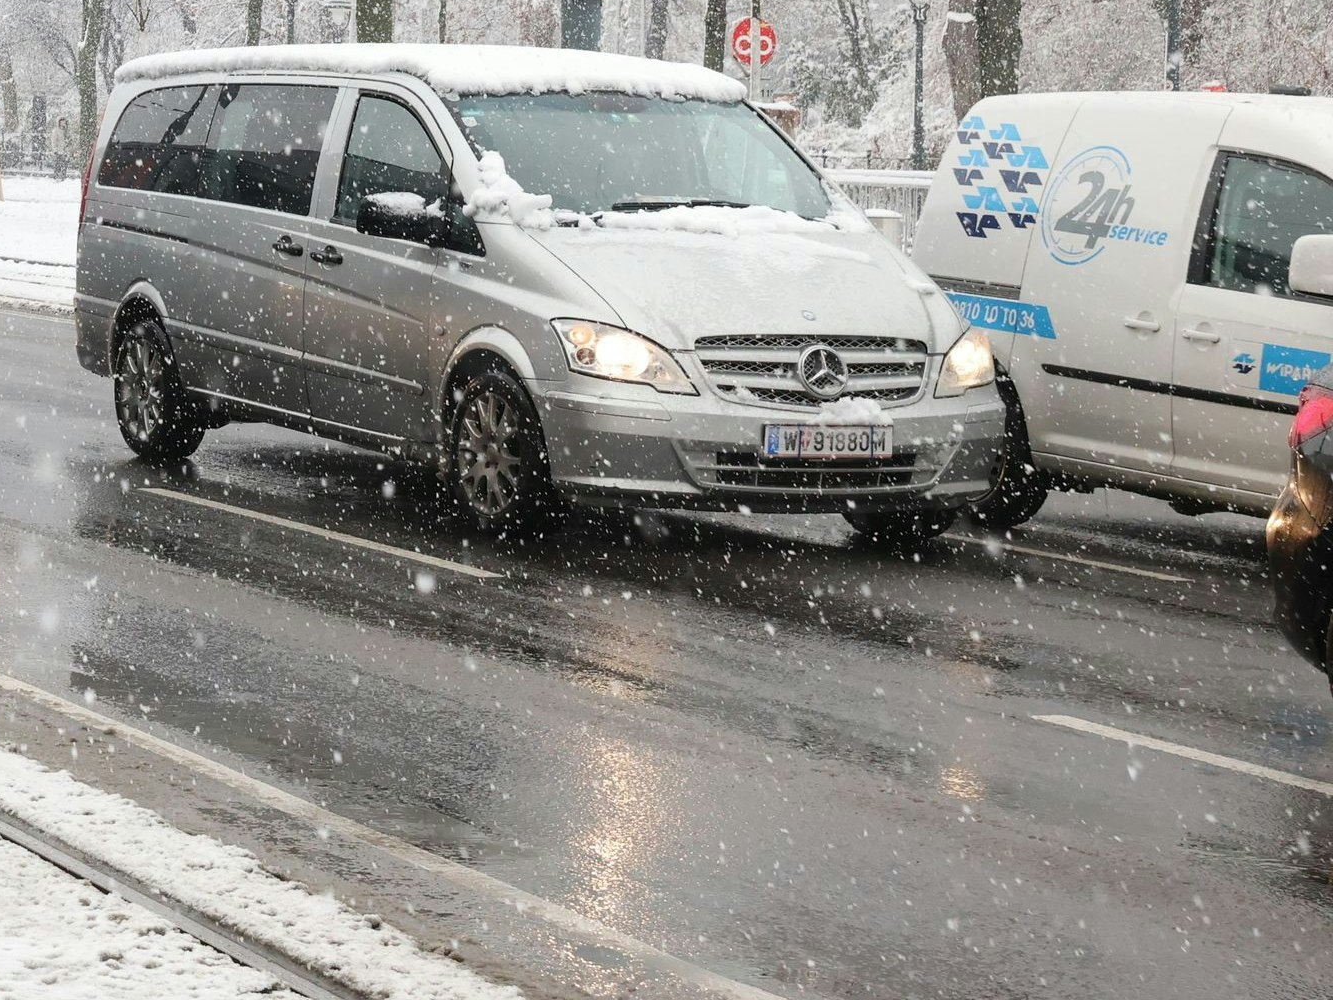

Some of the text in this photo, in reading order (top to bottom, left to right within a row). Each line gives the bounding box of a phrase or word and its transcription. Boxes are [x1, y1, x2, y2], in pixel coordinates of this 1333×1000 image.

[1053, 170, 1135, 250] 24h
[1108, 224, 1169, 246] service
[1019, 310, 1035, 328] 36
[783, 431, 798, 451] W
